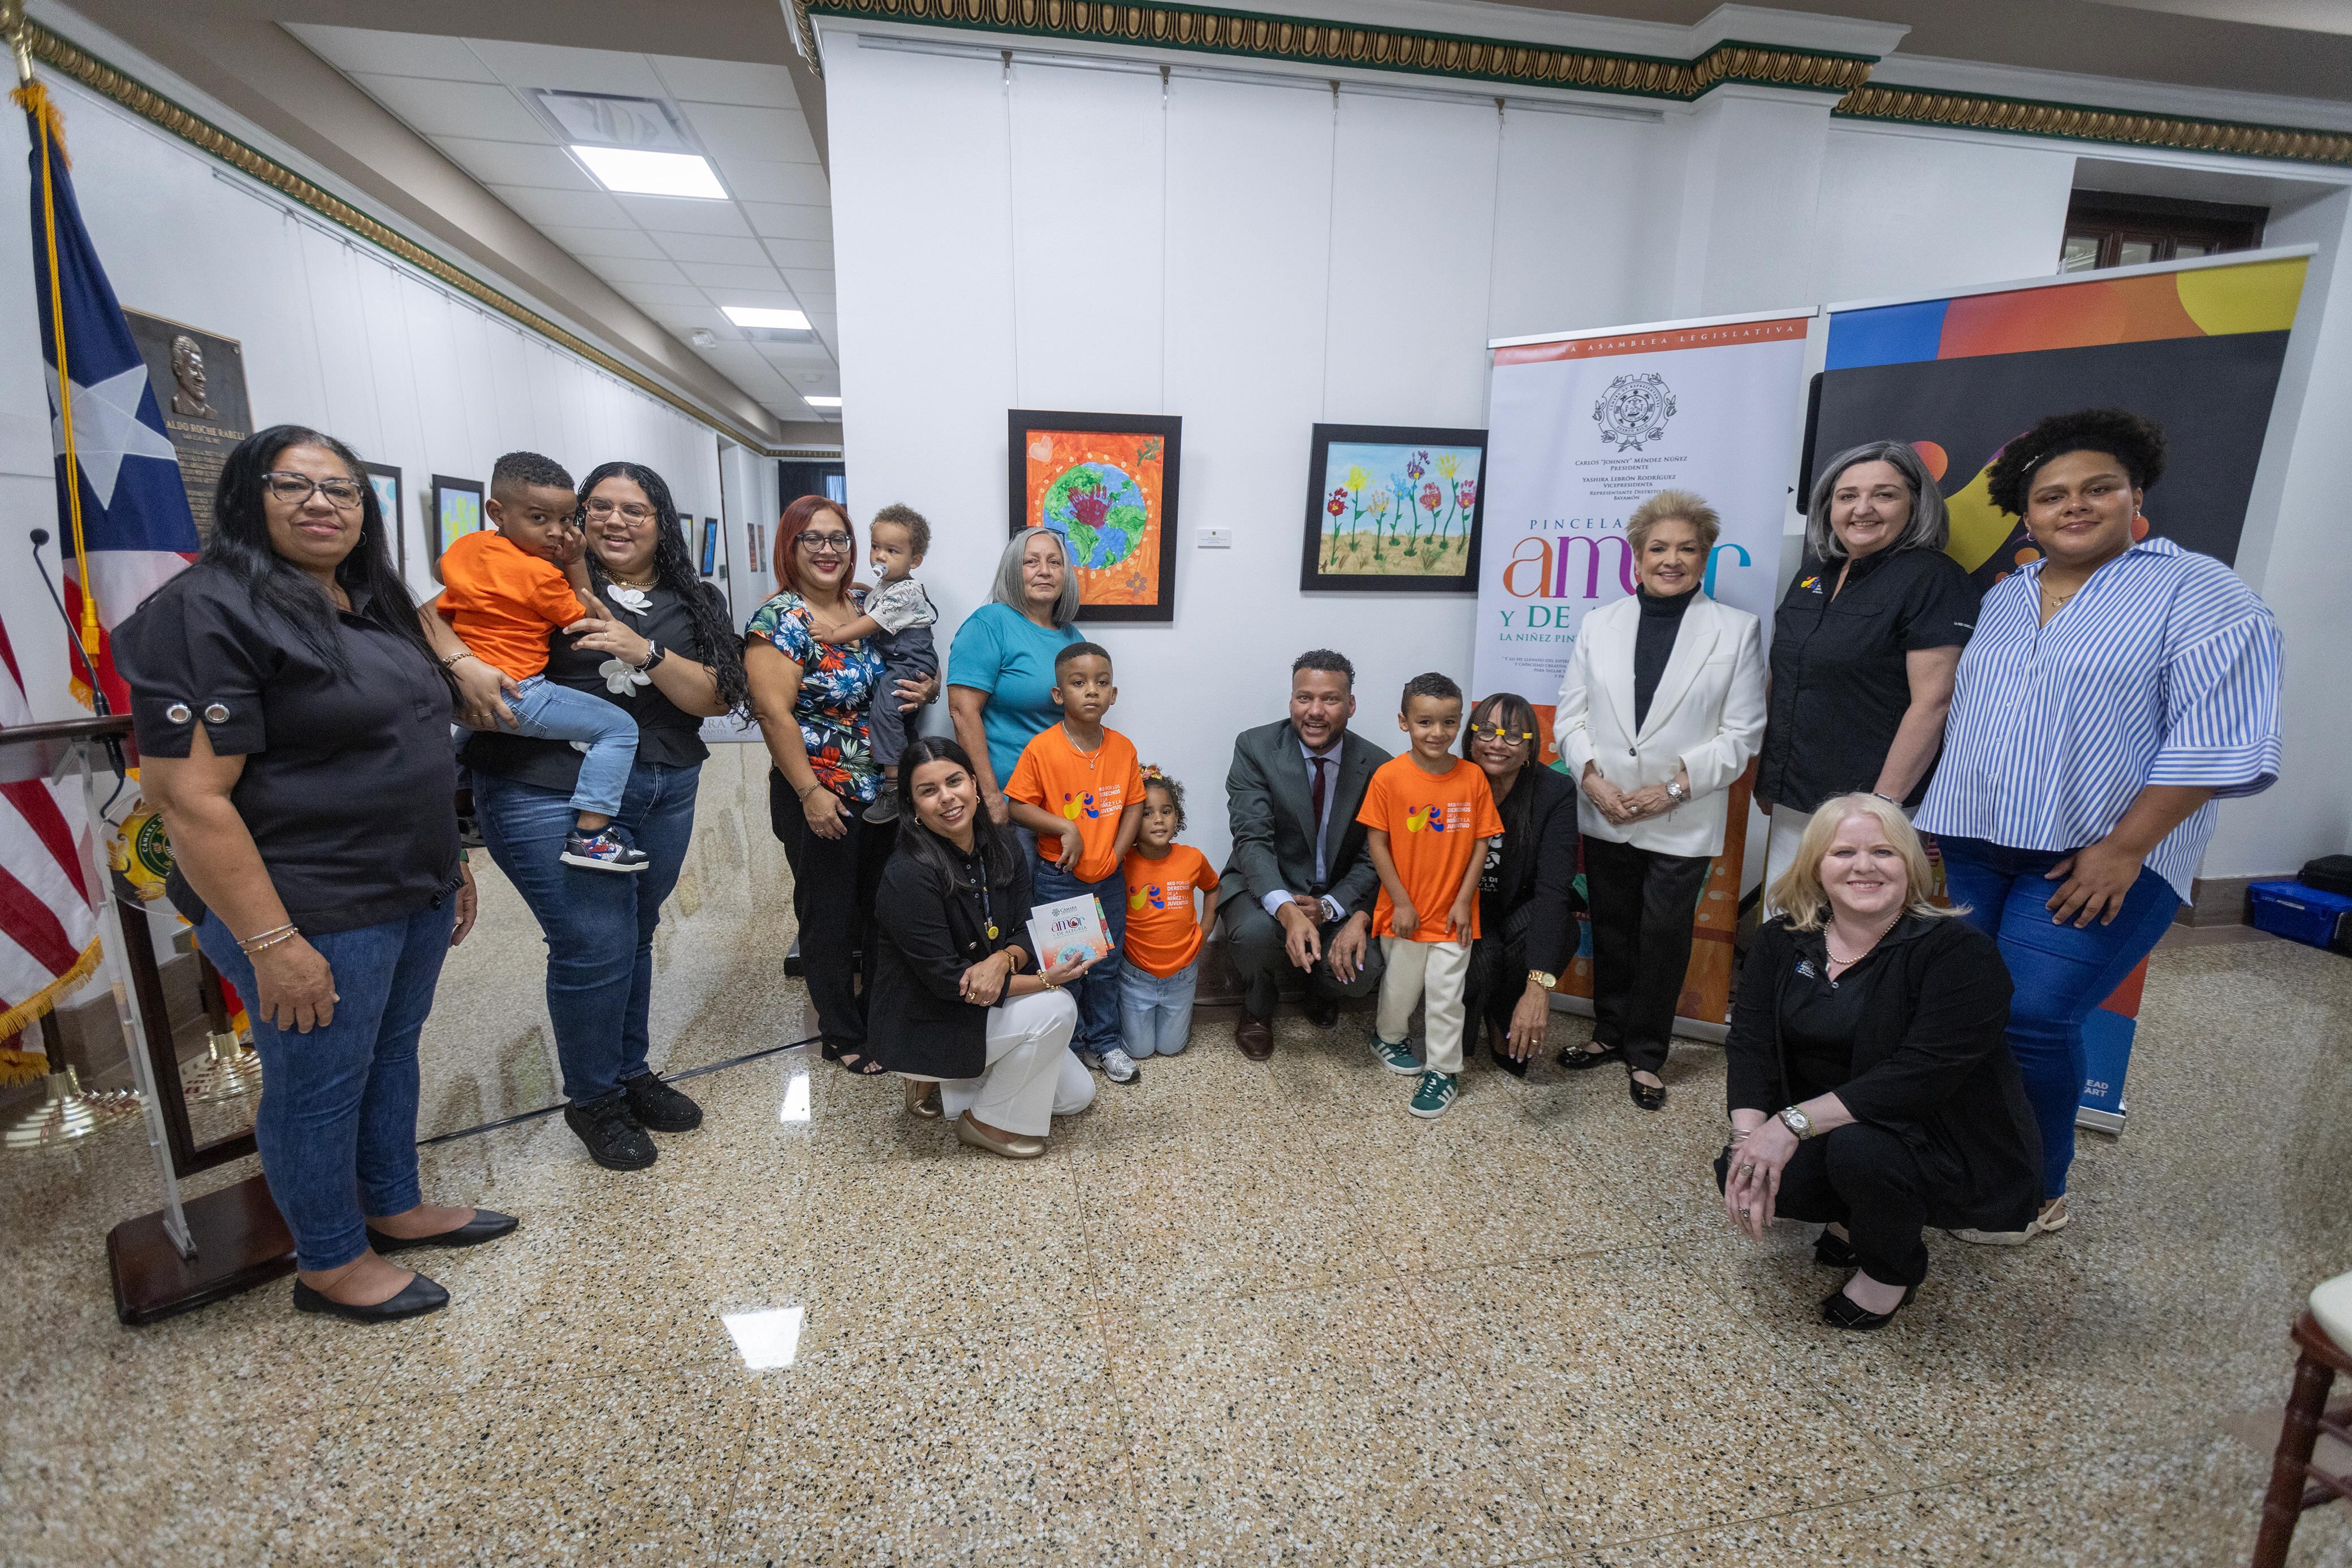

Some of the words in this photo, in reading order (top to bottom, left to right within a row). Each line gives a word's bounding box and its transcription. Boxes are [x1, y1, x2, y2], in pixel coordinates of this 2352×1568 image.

[1588, 338, 1667, 351] ASAMBLEA
[1680, 326, 1793, 342] LEGISLATIVA
[166, 420, 189, 431] ALDO
[1530, 518, 1623, 530] PINCELA
[1503, 535, 1751, 601] amr
[1499, 611, 1515, 627] Y
[1527, 605, 1570, 628] DE
[1516, 633, 1551, 642] NIÑEZ
[1052, 917, 1085, 933] amor
[2087, 1079, 2108, 1089] EAD
[2084, 1086, 2108, 1097] ART
